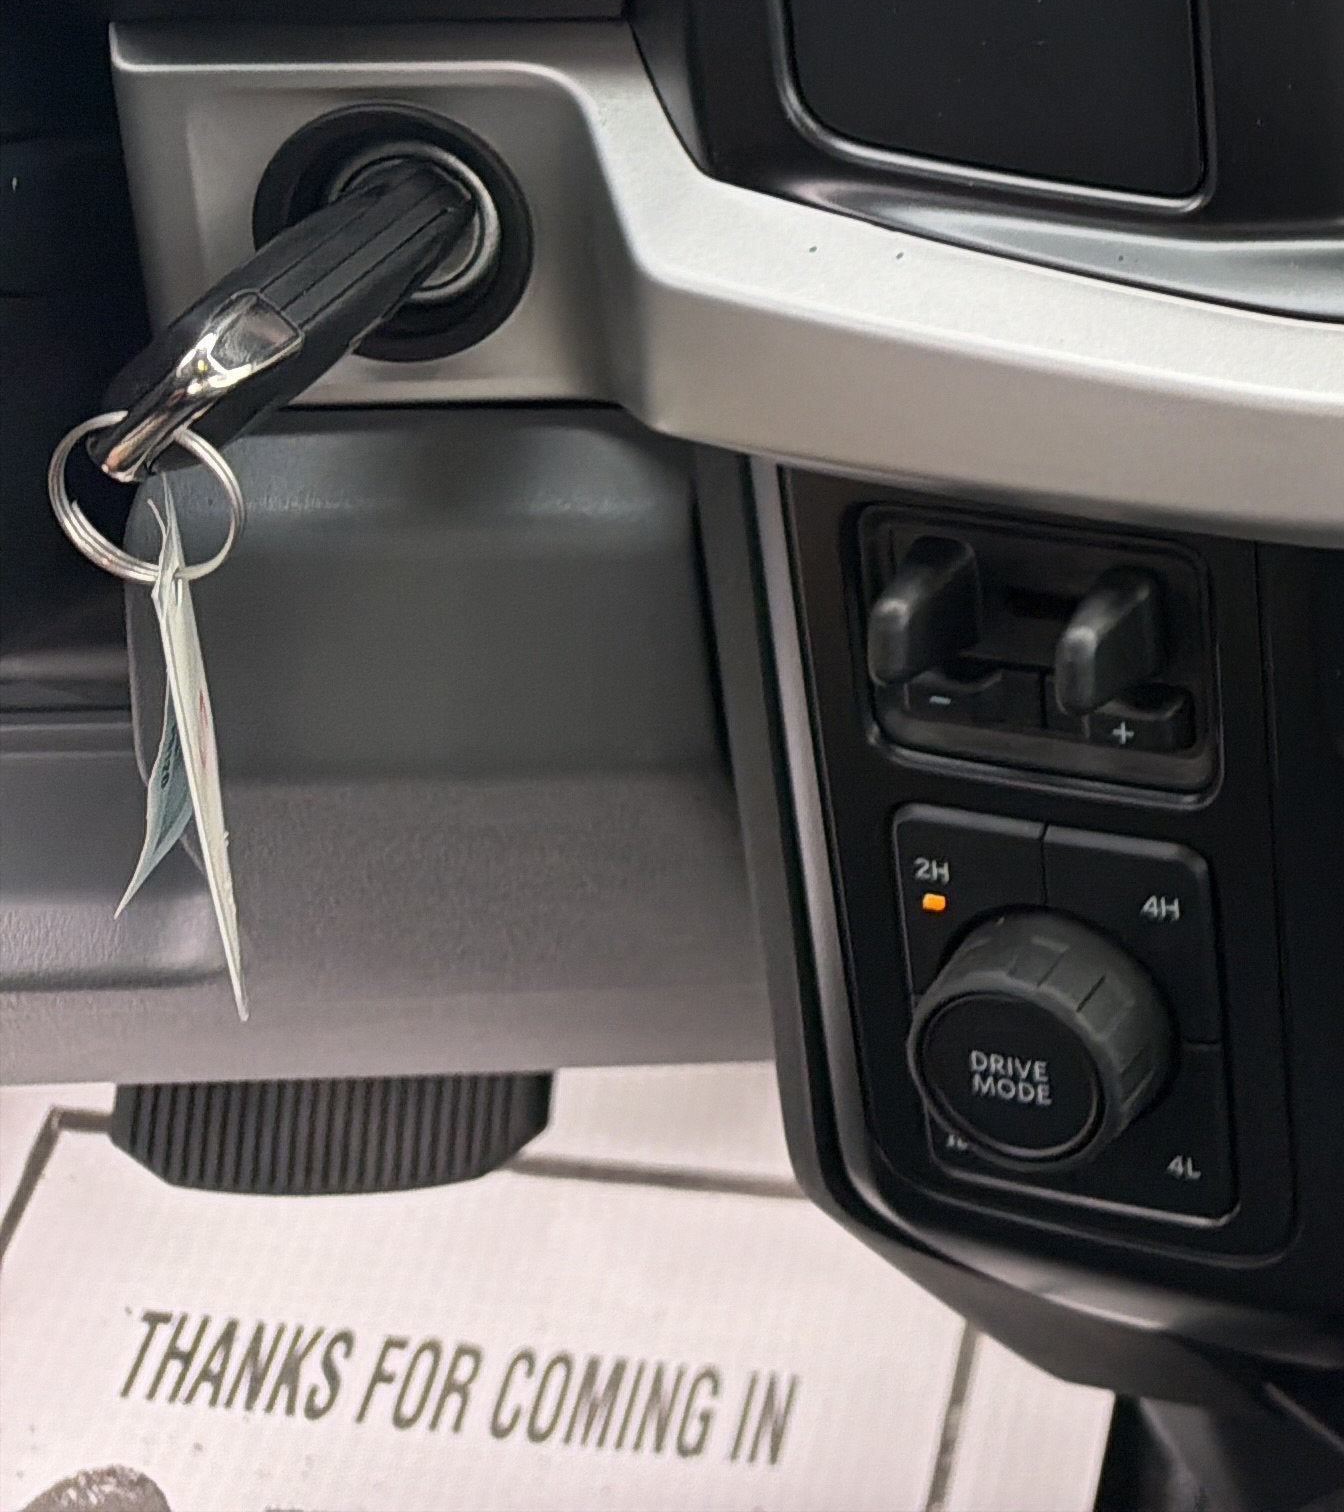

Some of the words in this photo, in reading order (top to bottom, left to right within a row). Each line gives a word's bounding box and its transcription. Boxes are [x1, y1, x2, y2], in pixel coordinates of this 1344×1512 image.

[914, 858, 950, 884] 2H
[1140, 895, 1180, 922] 4H
[970, 1049, 1049, 1083] DRIVE
[972, 1073, 1053, 1106] MODE
[1167, 1154, 1202, 1181] 4L
[120, 1308, 356, 1423] THANKS
[358, 1335, 481, 1435] FOR
[491, 1349, 724, 1460] COMING
[728, 1370, 802, 1467] IN
